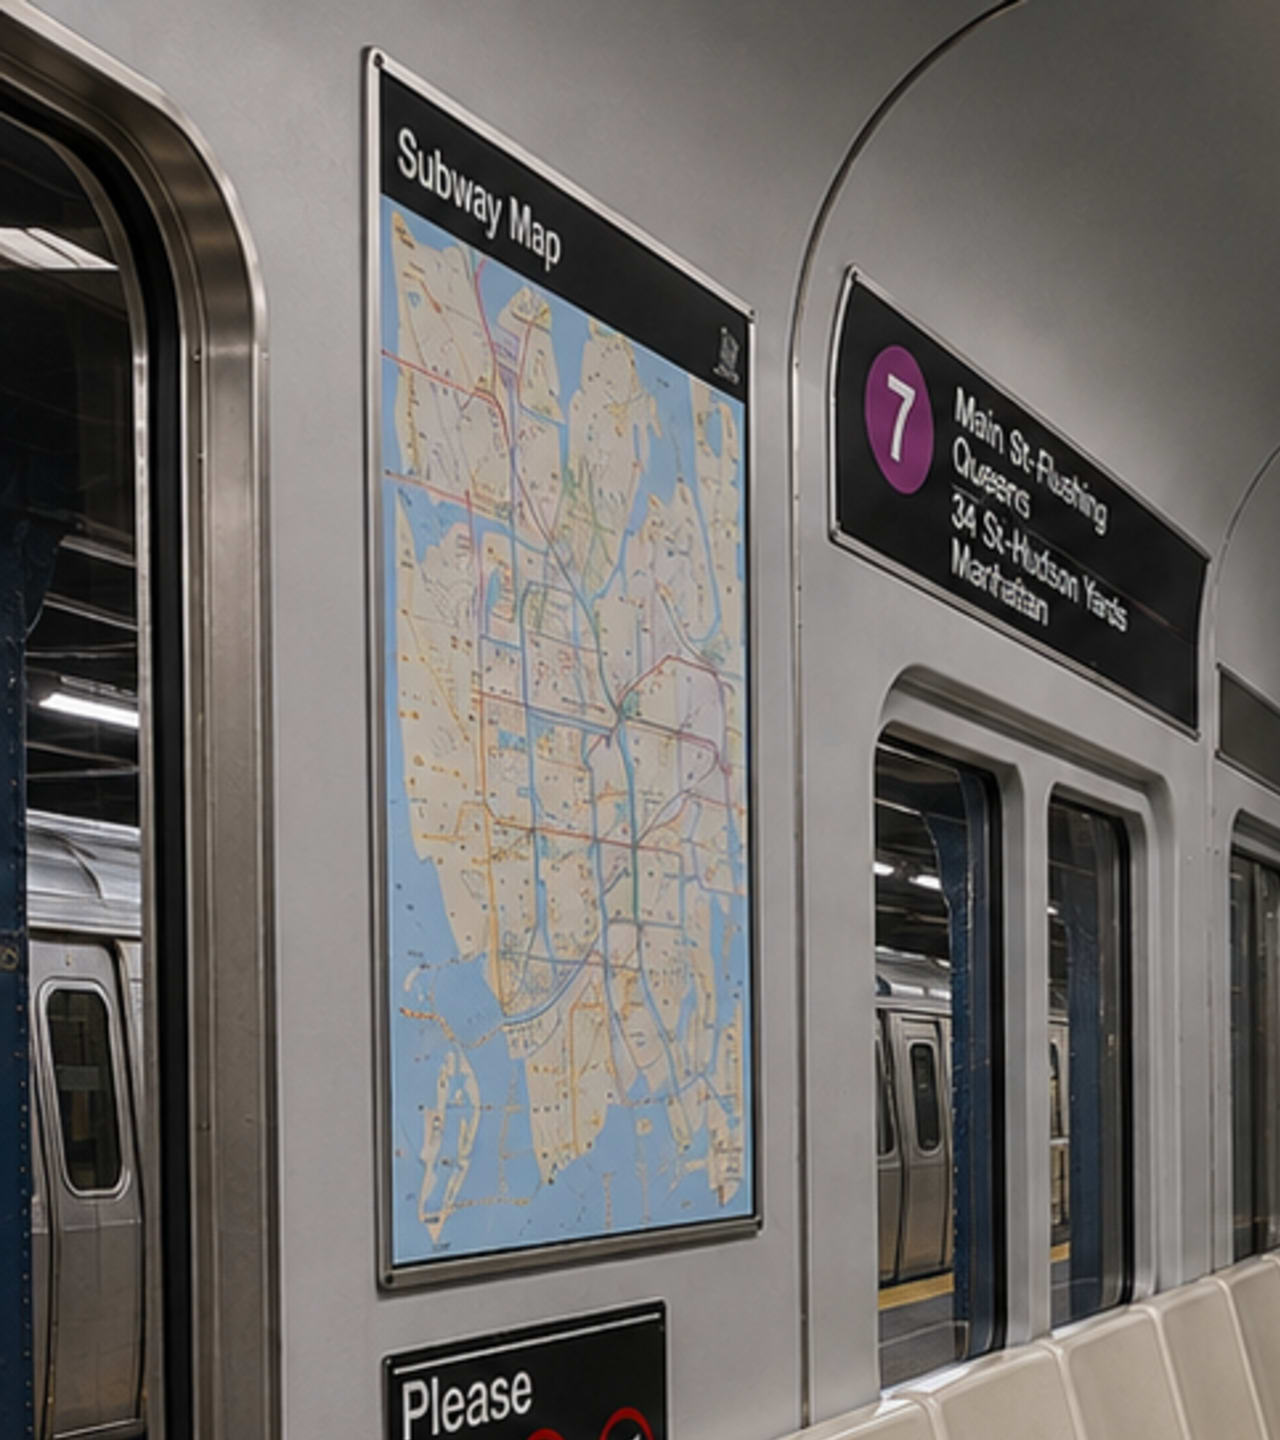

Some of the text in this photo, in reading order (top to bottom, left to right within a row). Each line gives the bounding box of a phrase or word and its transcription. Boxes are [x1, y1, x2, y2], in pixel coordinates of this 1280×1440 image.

[398, 127, 561, 272] Subway Map
[887, 373, 916, 462] 7
[954, 386, 1004, 454] Main
